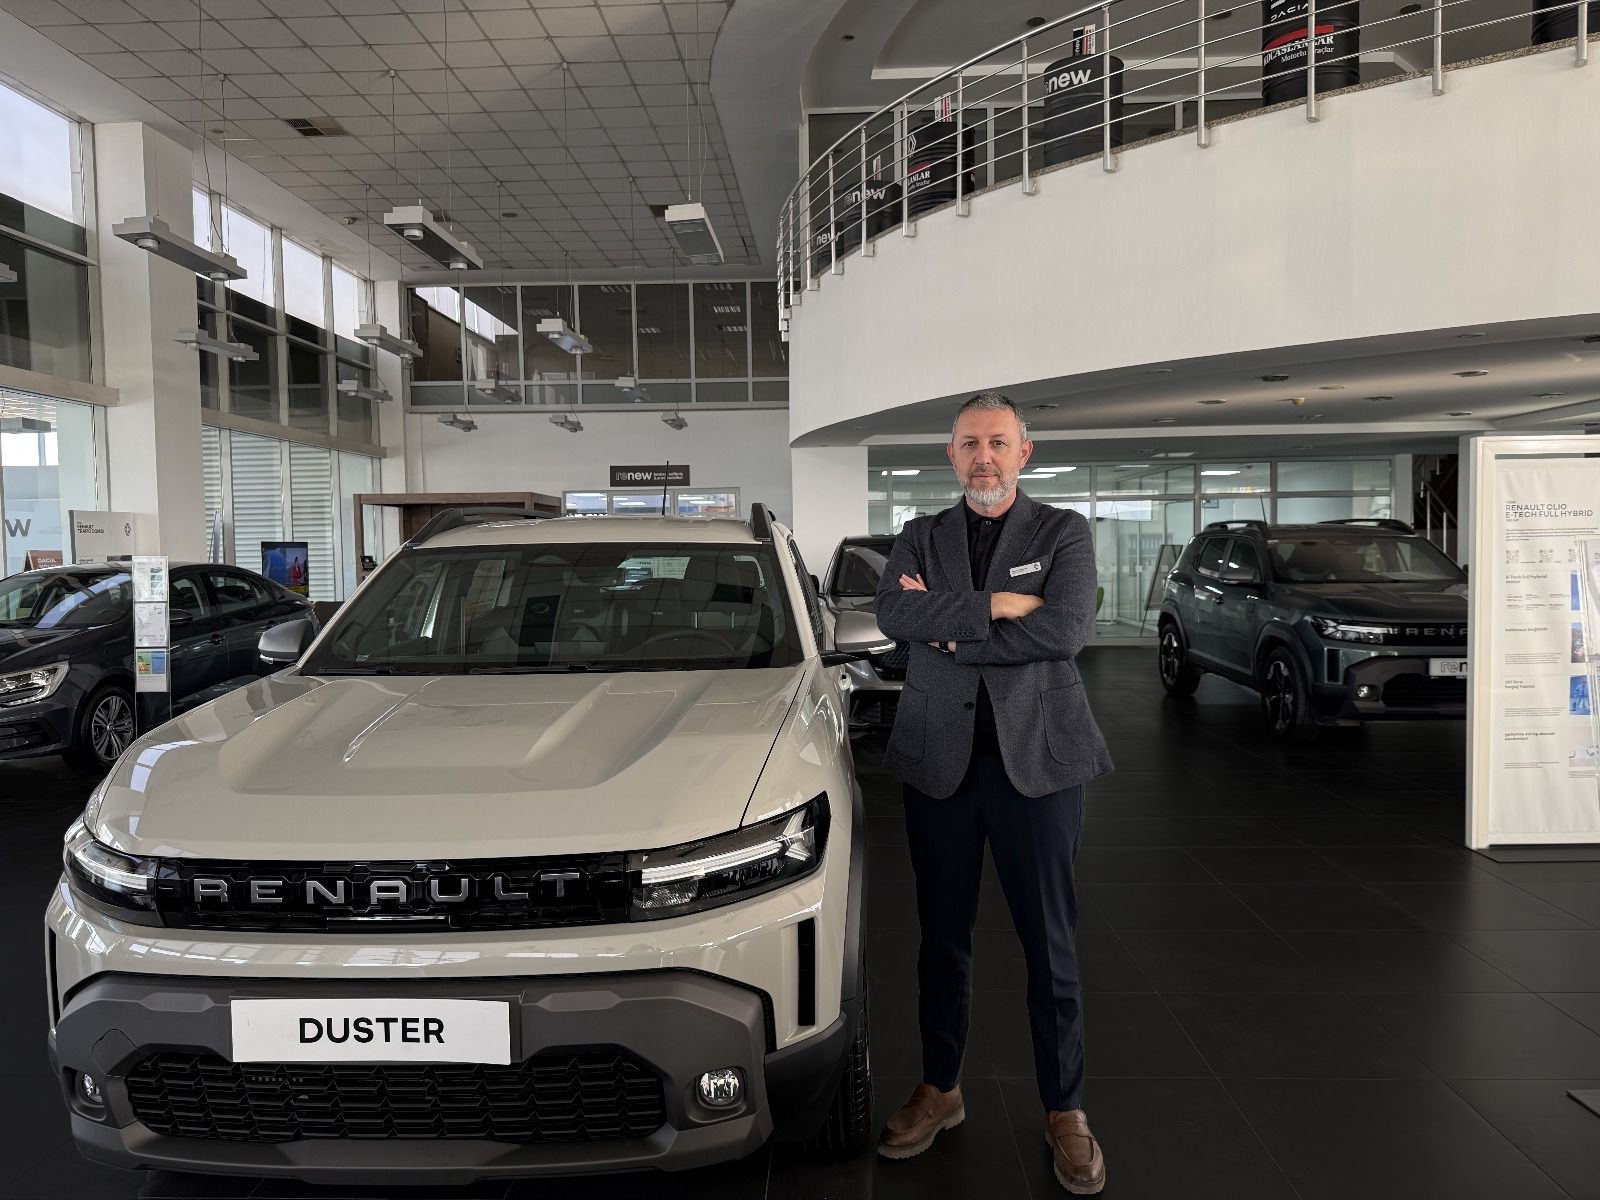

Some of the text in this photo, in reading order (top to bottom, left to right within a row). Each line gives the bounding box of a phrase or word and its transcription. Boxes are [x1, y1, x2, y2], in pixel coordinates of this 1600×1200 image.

[615, 471, 652, 481] renew
[1505, 503, 1567, 512] RENAULT CLIO
[1505, 509, 1594, 519] E-TECH FULL HYBRID
[1405, 627, 1468, 636] RENA
[1440, 661, 1468, 673] ren
[193, 871, 580, 904] RENAULT
[299, 1017, 446, 1044] DUSTER
